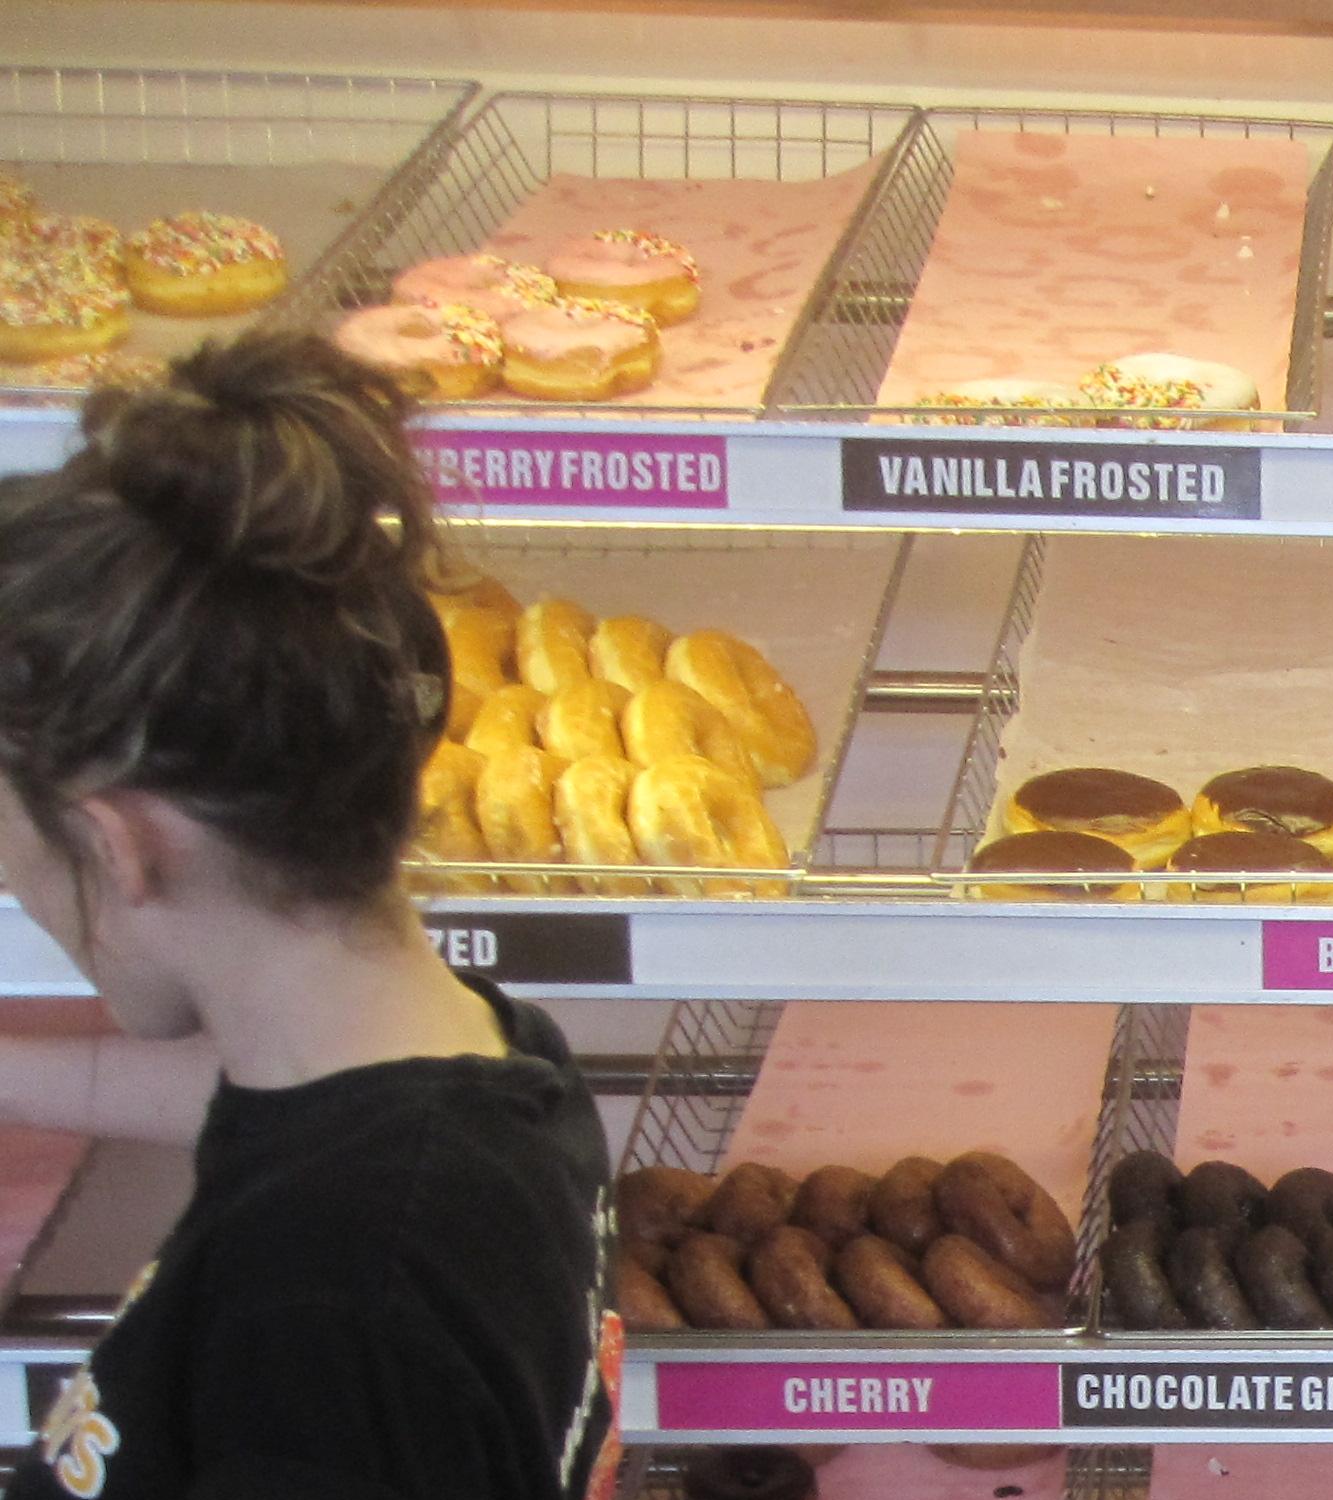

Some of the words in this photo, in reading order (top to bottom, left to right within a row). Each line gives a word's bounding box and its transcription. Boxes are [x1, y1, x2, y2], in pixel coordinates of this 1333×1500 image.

[559, 449, 722, 492] FROSTED
[879, 456, 1044, 498] VANILLA
[1050, 460, 1226, 505] FROSTED
[784, 1377, 933, 1414] CHERRY
[1077, 1373, 1294, 1411] CHOCOLATE
